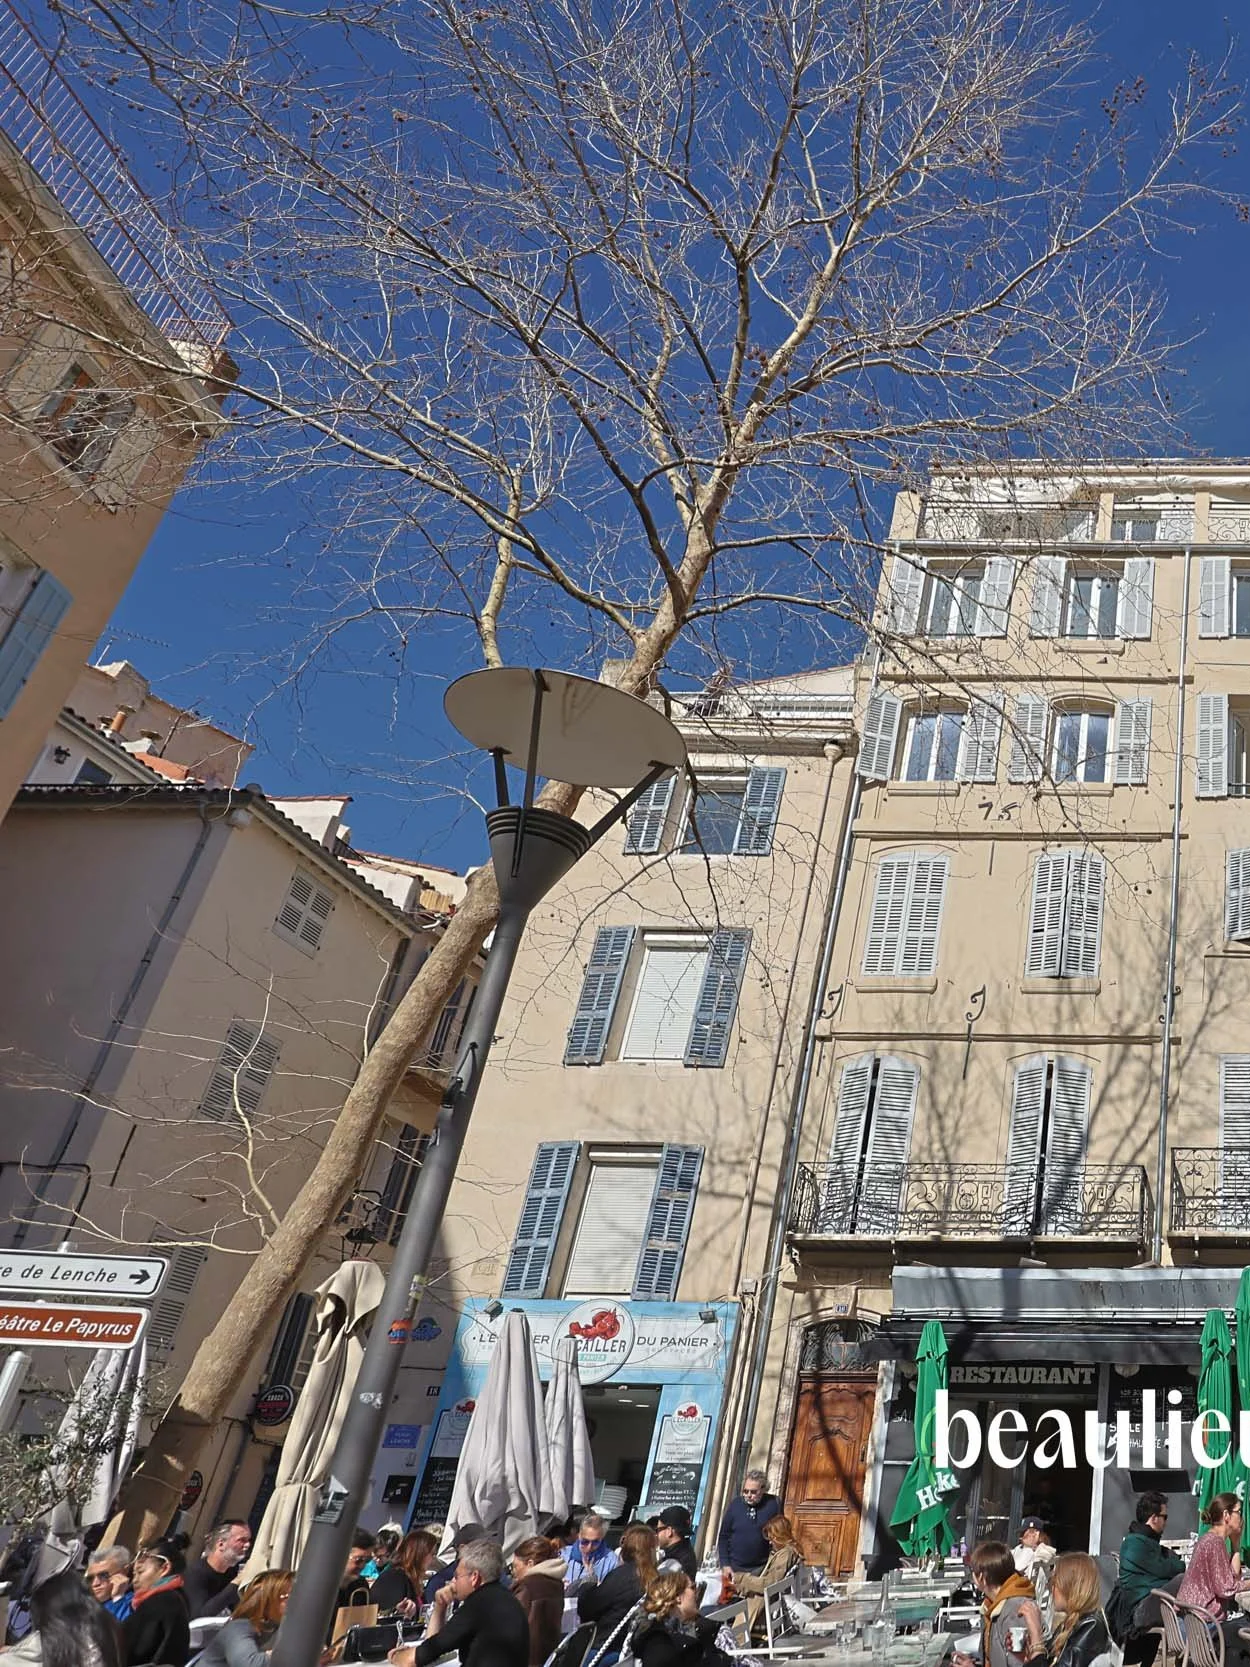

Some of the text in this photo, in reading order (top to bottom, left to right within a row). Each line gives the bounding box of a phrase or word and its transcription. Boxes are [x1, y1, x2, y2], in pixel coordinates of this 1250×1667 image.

[21, 1265, 43, 1279] de
[50, 1265, 117, 1283] Lenche
[42, 1317, 63, 1332] Le
[65, 1318, 133, 1338] Papyrus
[637, 1336, 656, 1346] DU
[660, 1337, 708, 1347] PANIER
[950, 1366, 1095, 1385] RESTAURANT
